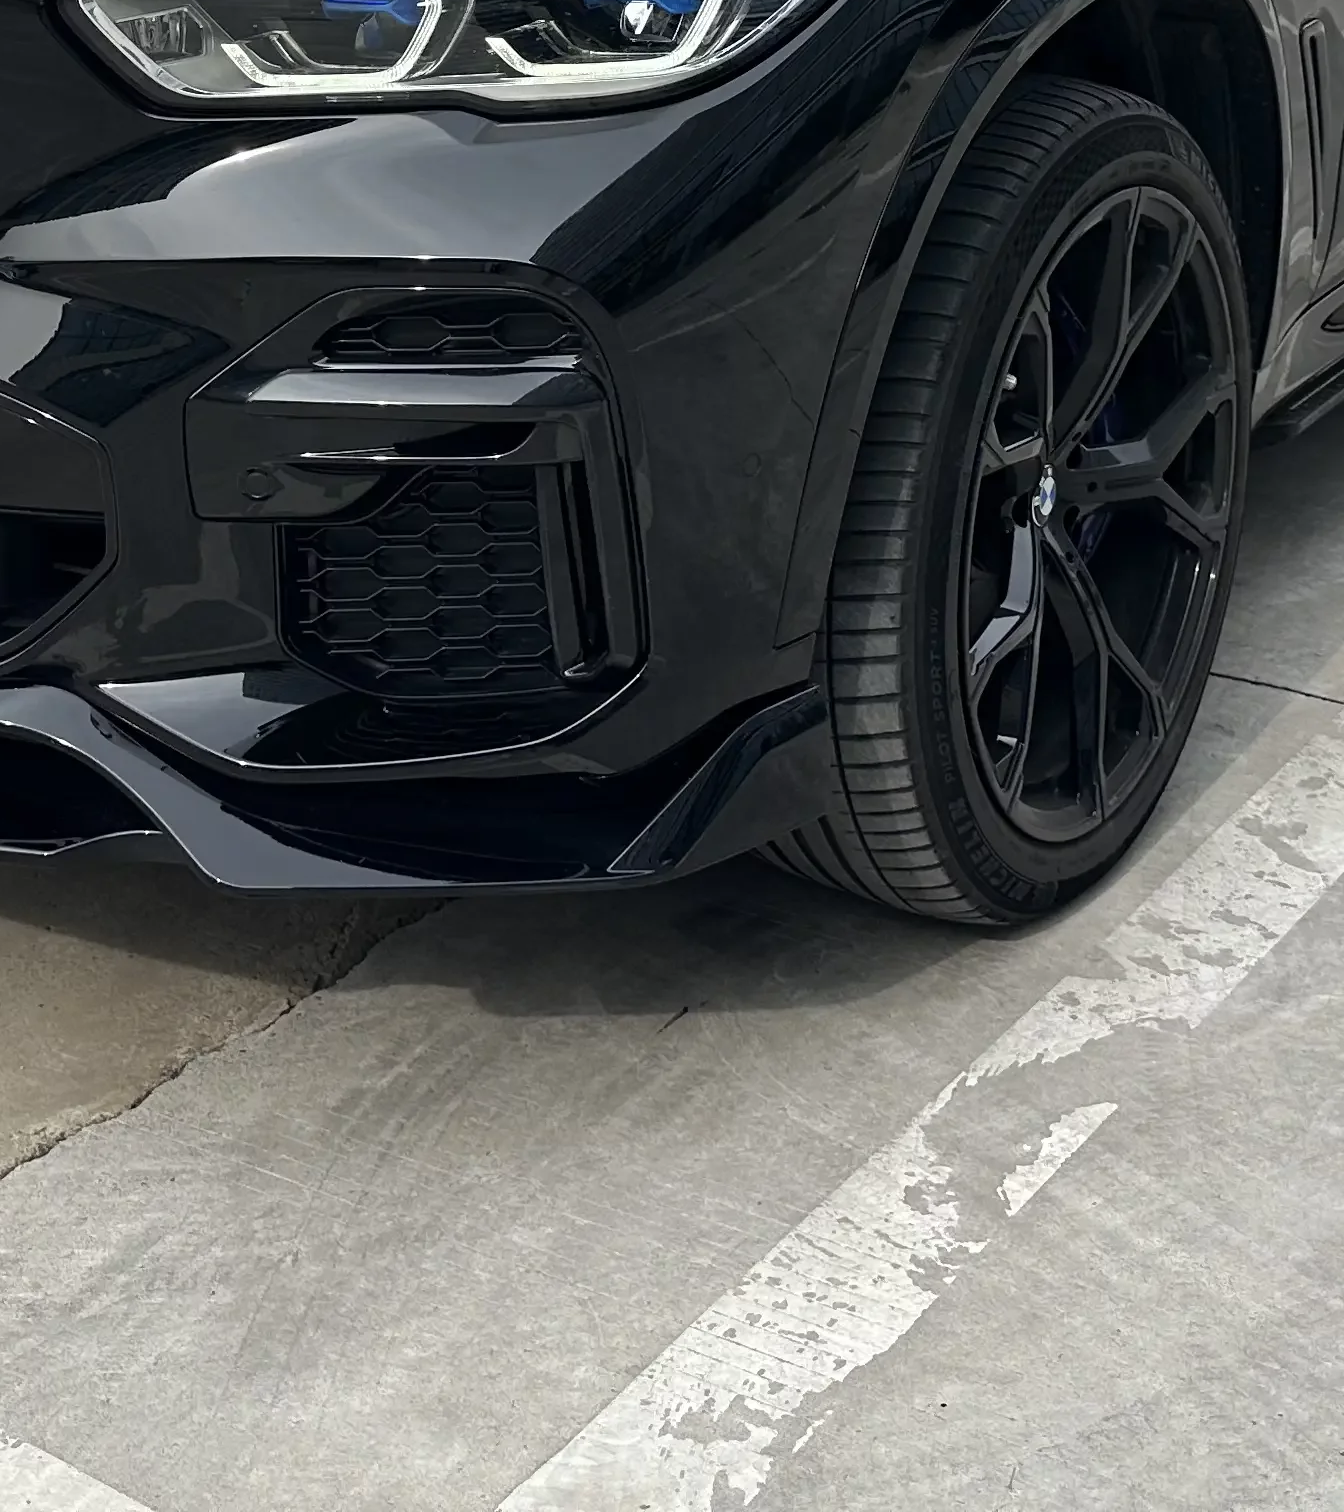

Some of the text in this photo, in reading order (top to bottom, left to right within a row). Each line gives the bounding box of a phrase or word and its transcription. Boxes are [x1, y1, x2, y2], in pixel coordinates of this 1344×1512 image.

[930, 651, 946, 722] SPORT
[937, 733, 957, 785] PILOT
[948, 796, 1034, 902] MICHELIN
